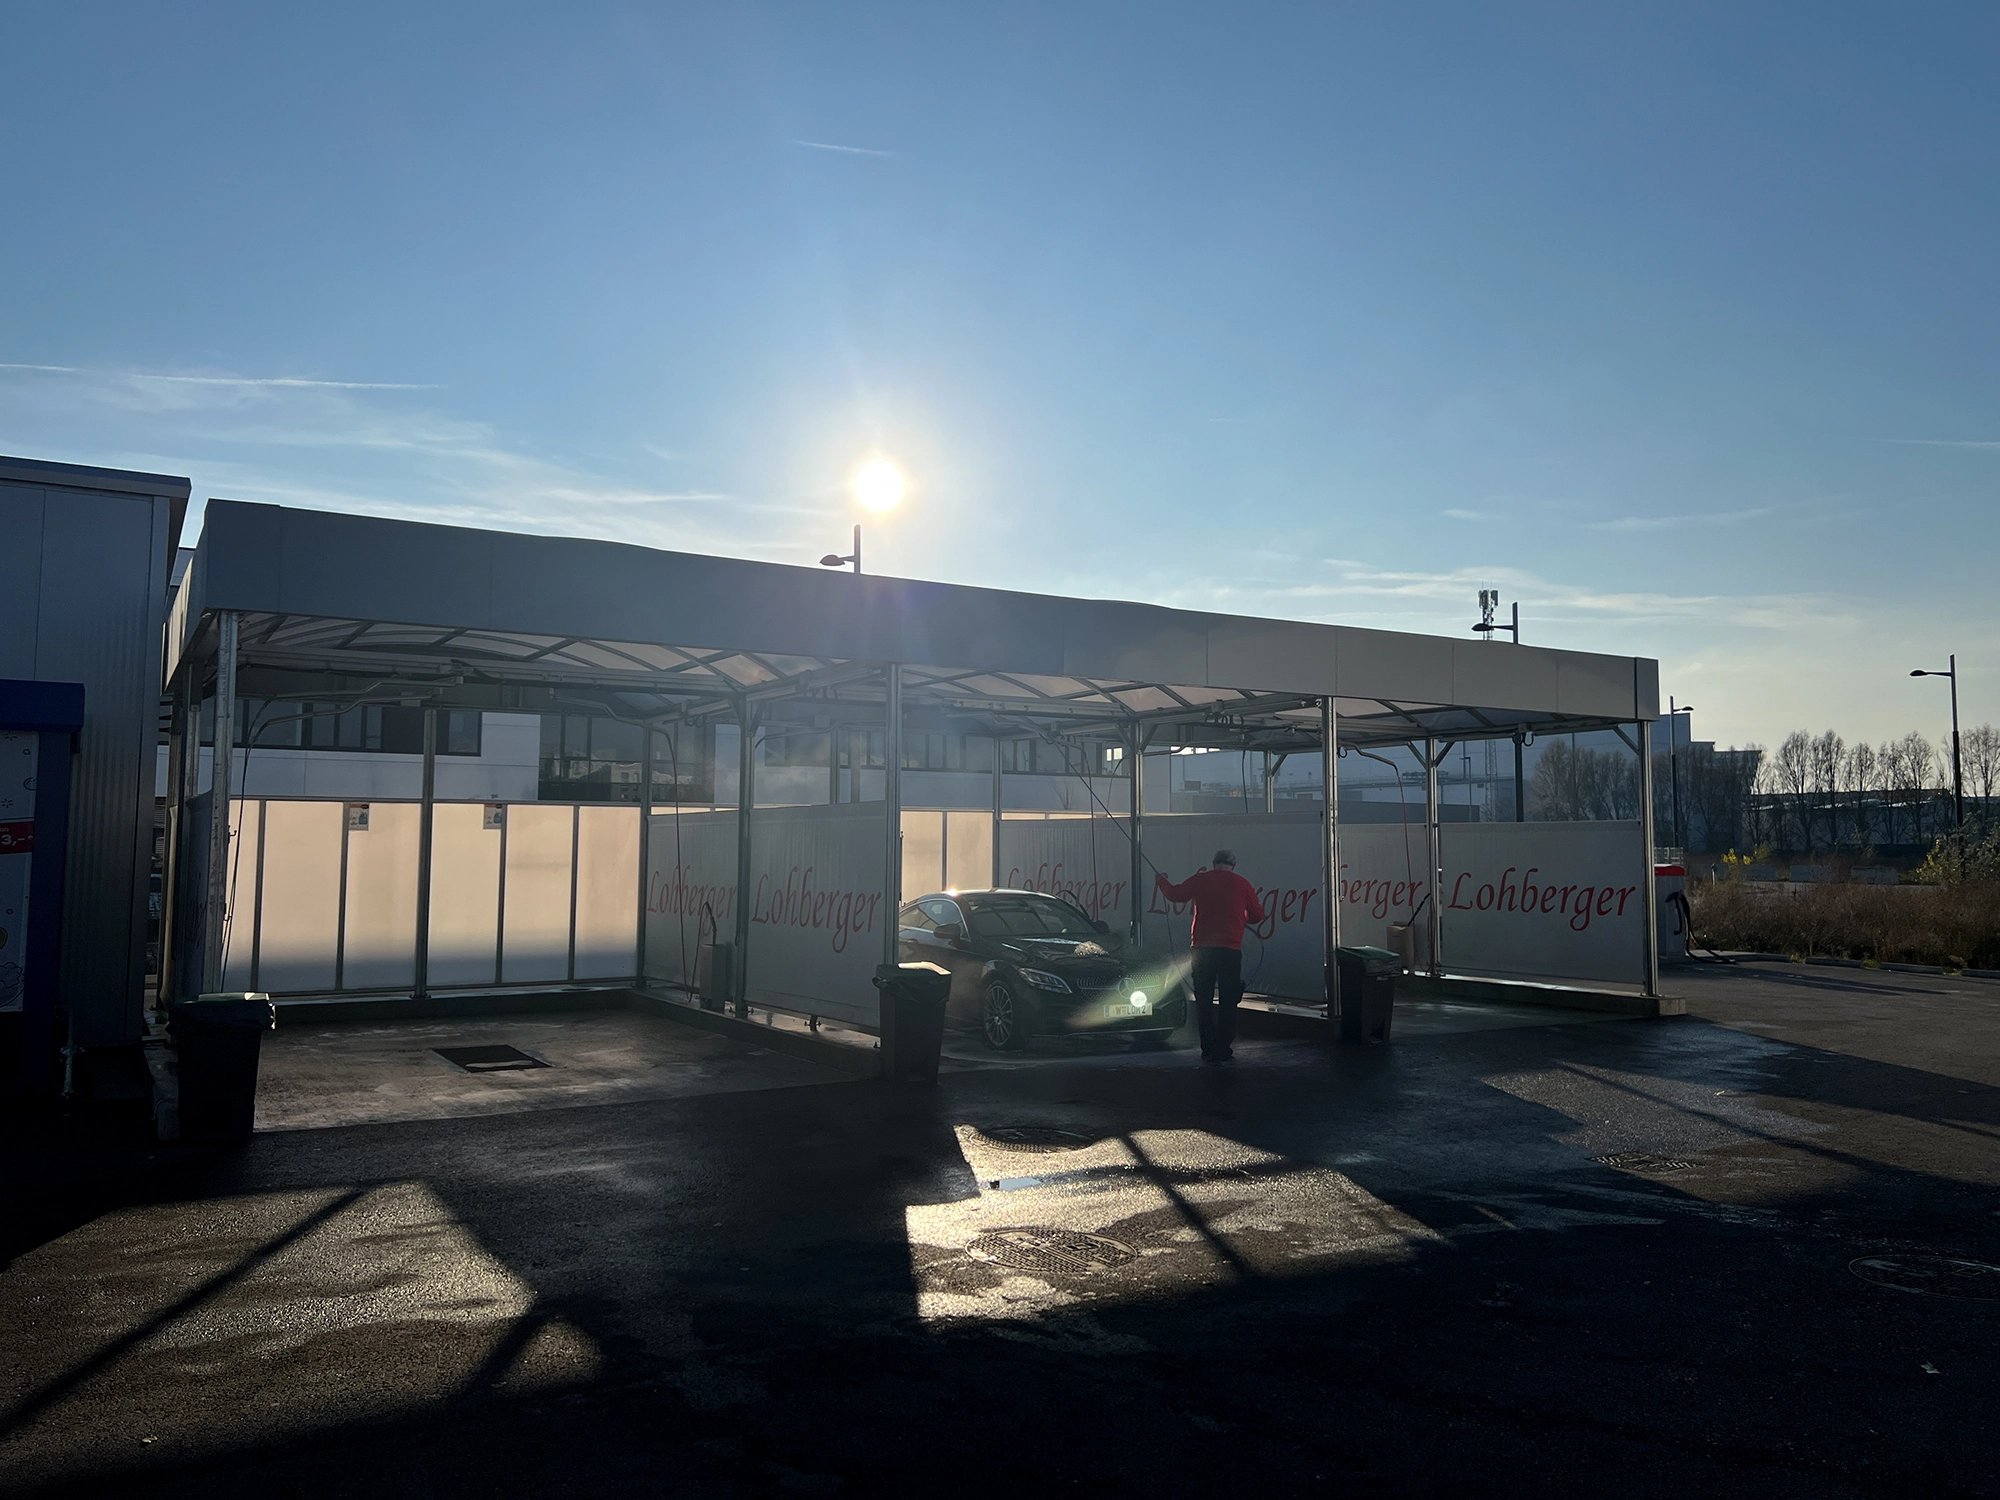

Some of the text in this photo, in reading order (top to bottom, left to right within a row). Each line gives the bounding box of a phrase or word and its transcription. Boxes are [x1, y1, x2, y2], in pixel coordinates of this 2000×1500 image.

[647, 864, 737, 937] Lohberger
[752, 866, 882, 954] Lohberger
[1339, 863, 1423, 919] berger
[1448, 867, 1636, 931] Lohberger
